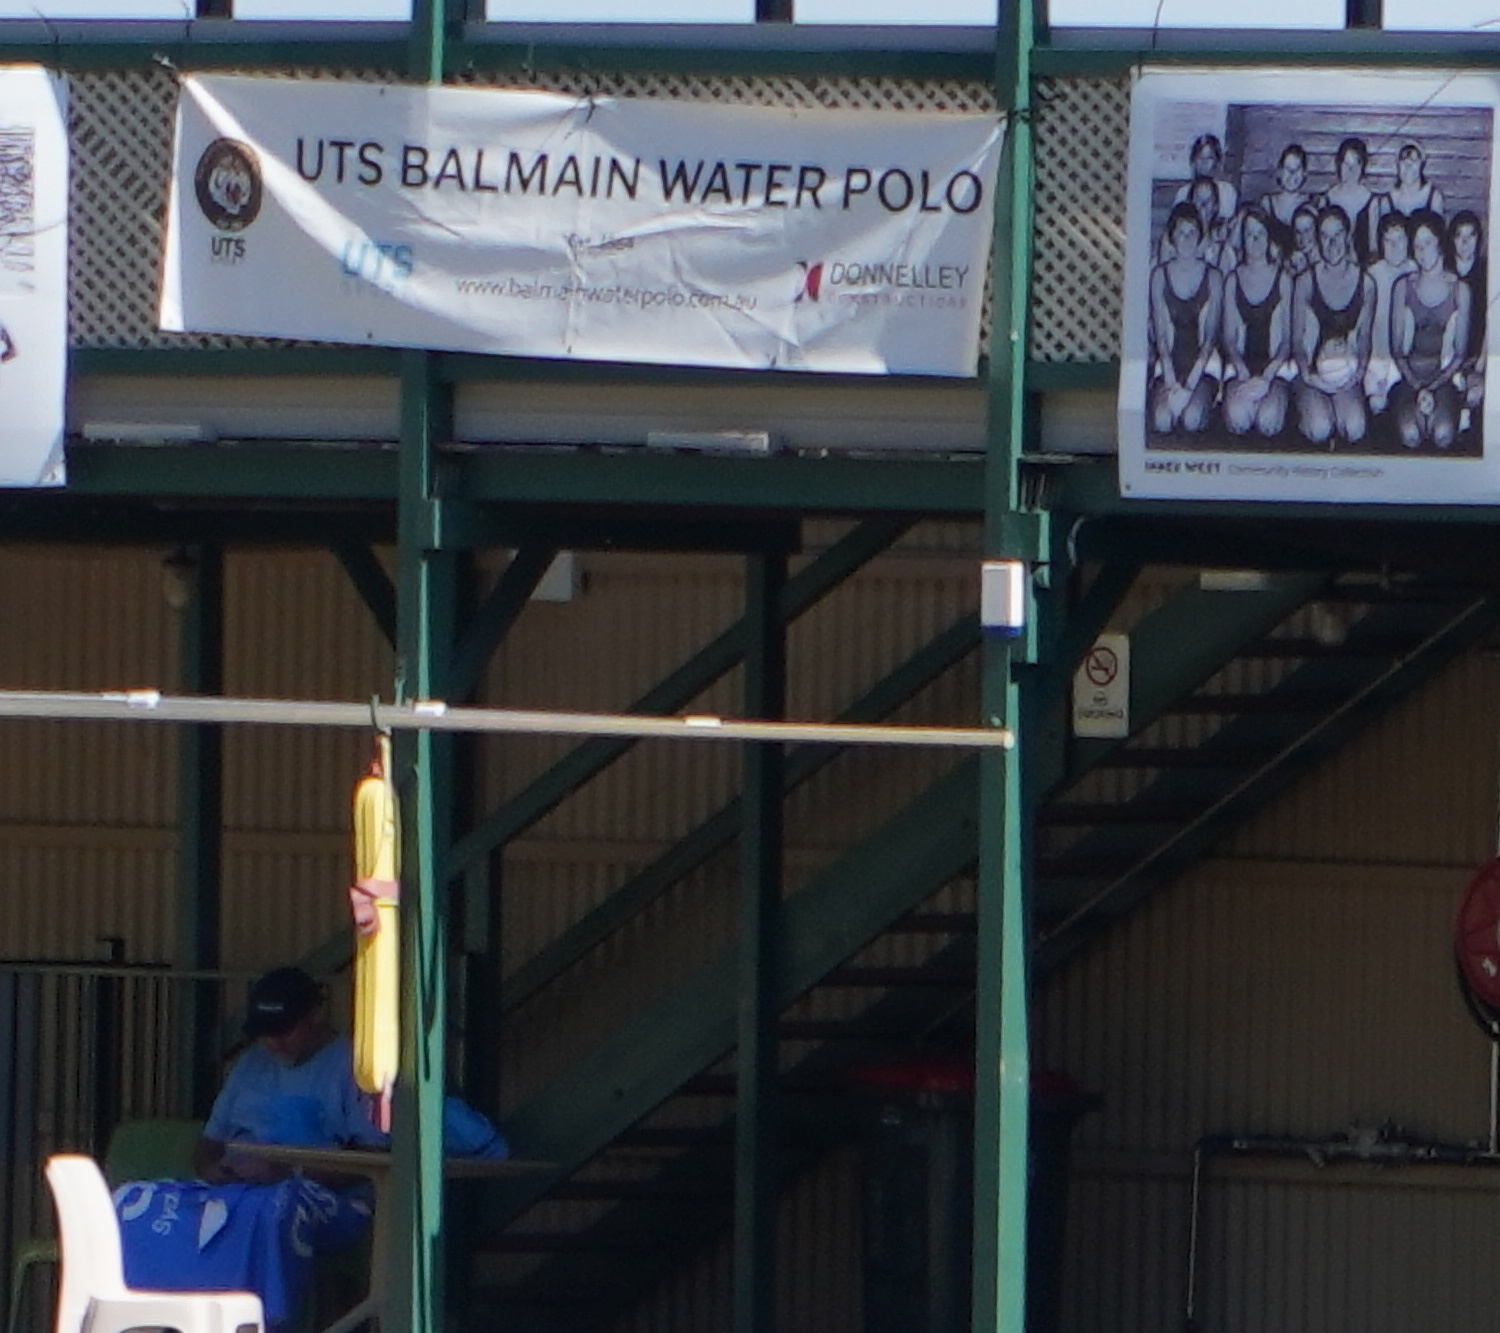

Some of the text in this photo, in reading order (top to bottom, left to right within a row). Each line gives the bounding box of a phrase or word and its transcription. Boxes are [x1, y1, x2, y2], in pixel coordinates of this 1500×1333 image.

[295, 137, 985, 215] UTS BALMAIN WATER POLO
[340, 239, 416, 277] UTS
[829, 261, 970, 289] DONNELLEY
